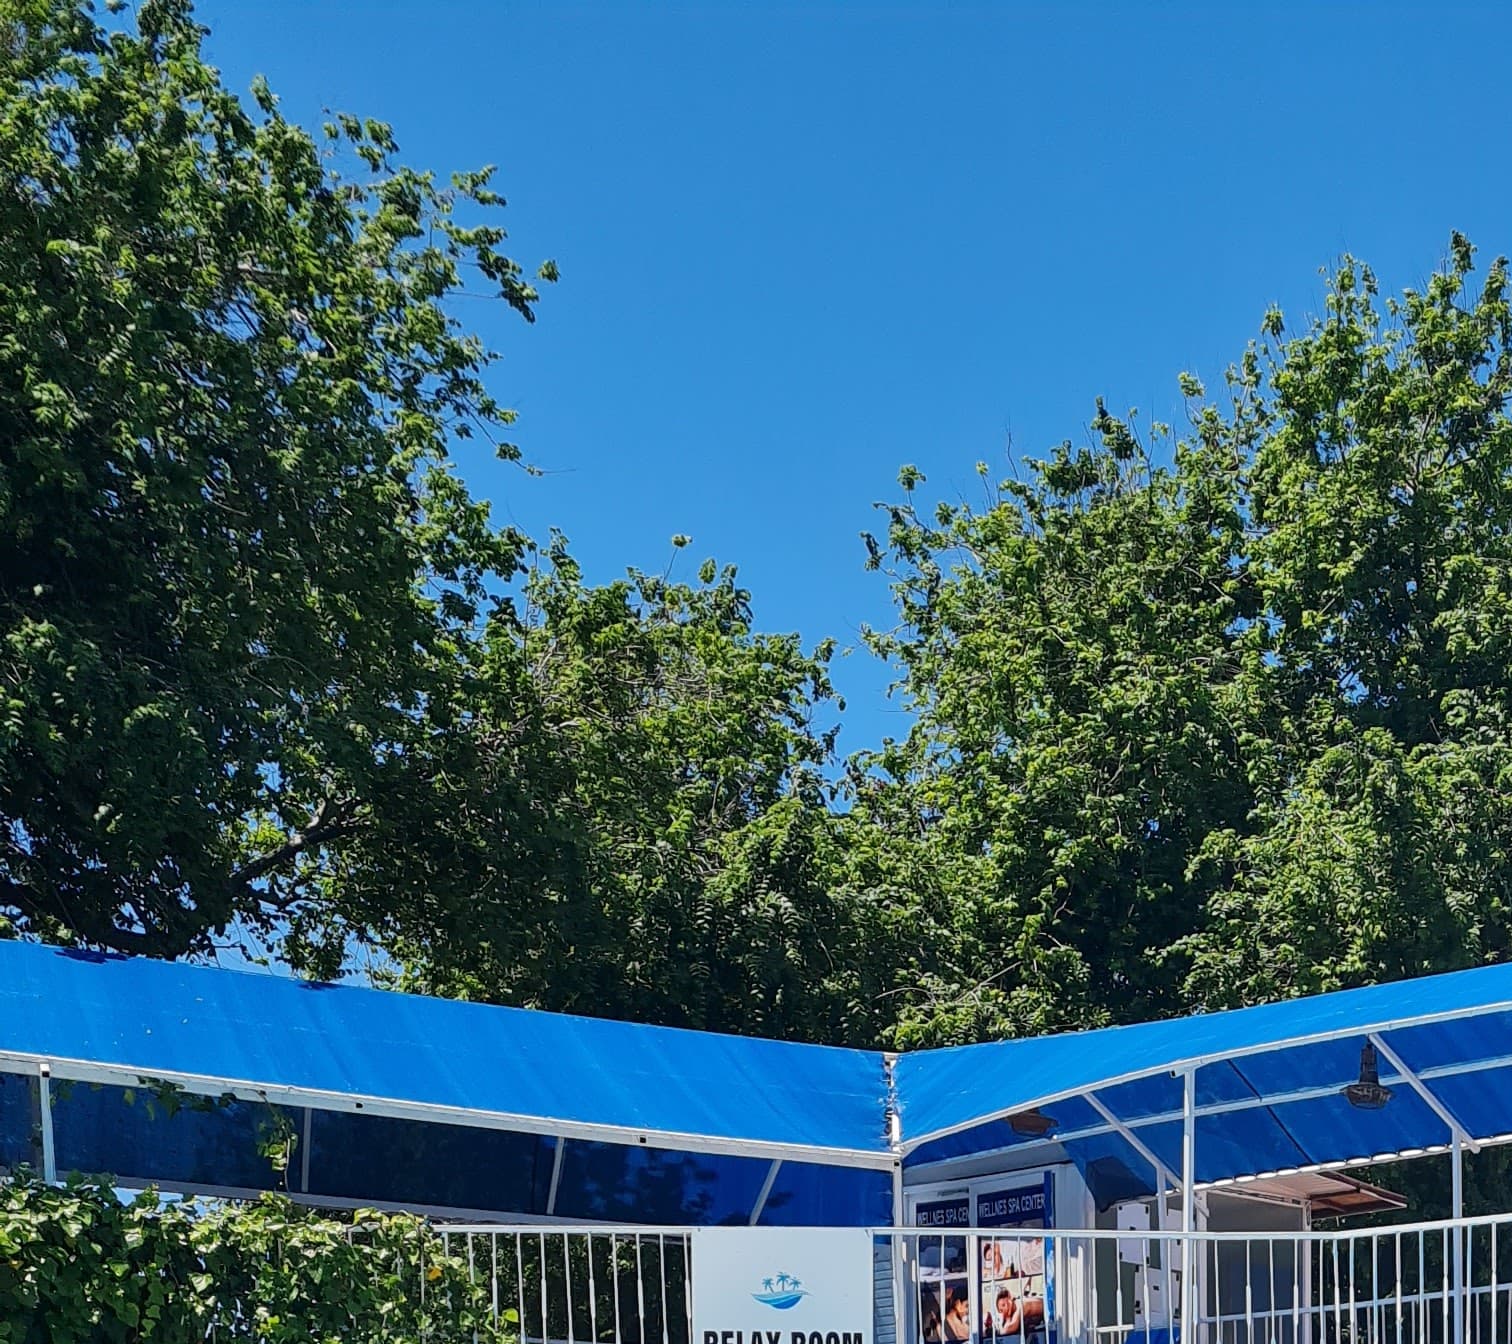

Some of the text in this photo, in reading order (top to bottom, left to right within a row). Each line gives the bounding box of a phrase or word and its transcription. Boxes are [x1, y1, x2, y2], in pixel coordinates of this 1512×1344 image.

[1008, 1197, 1020, 1214] SPA
[1021, 1193, 1045, 1212] CENTER
[946, 1208, 957, 1223] SPA
